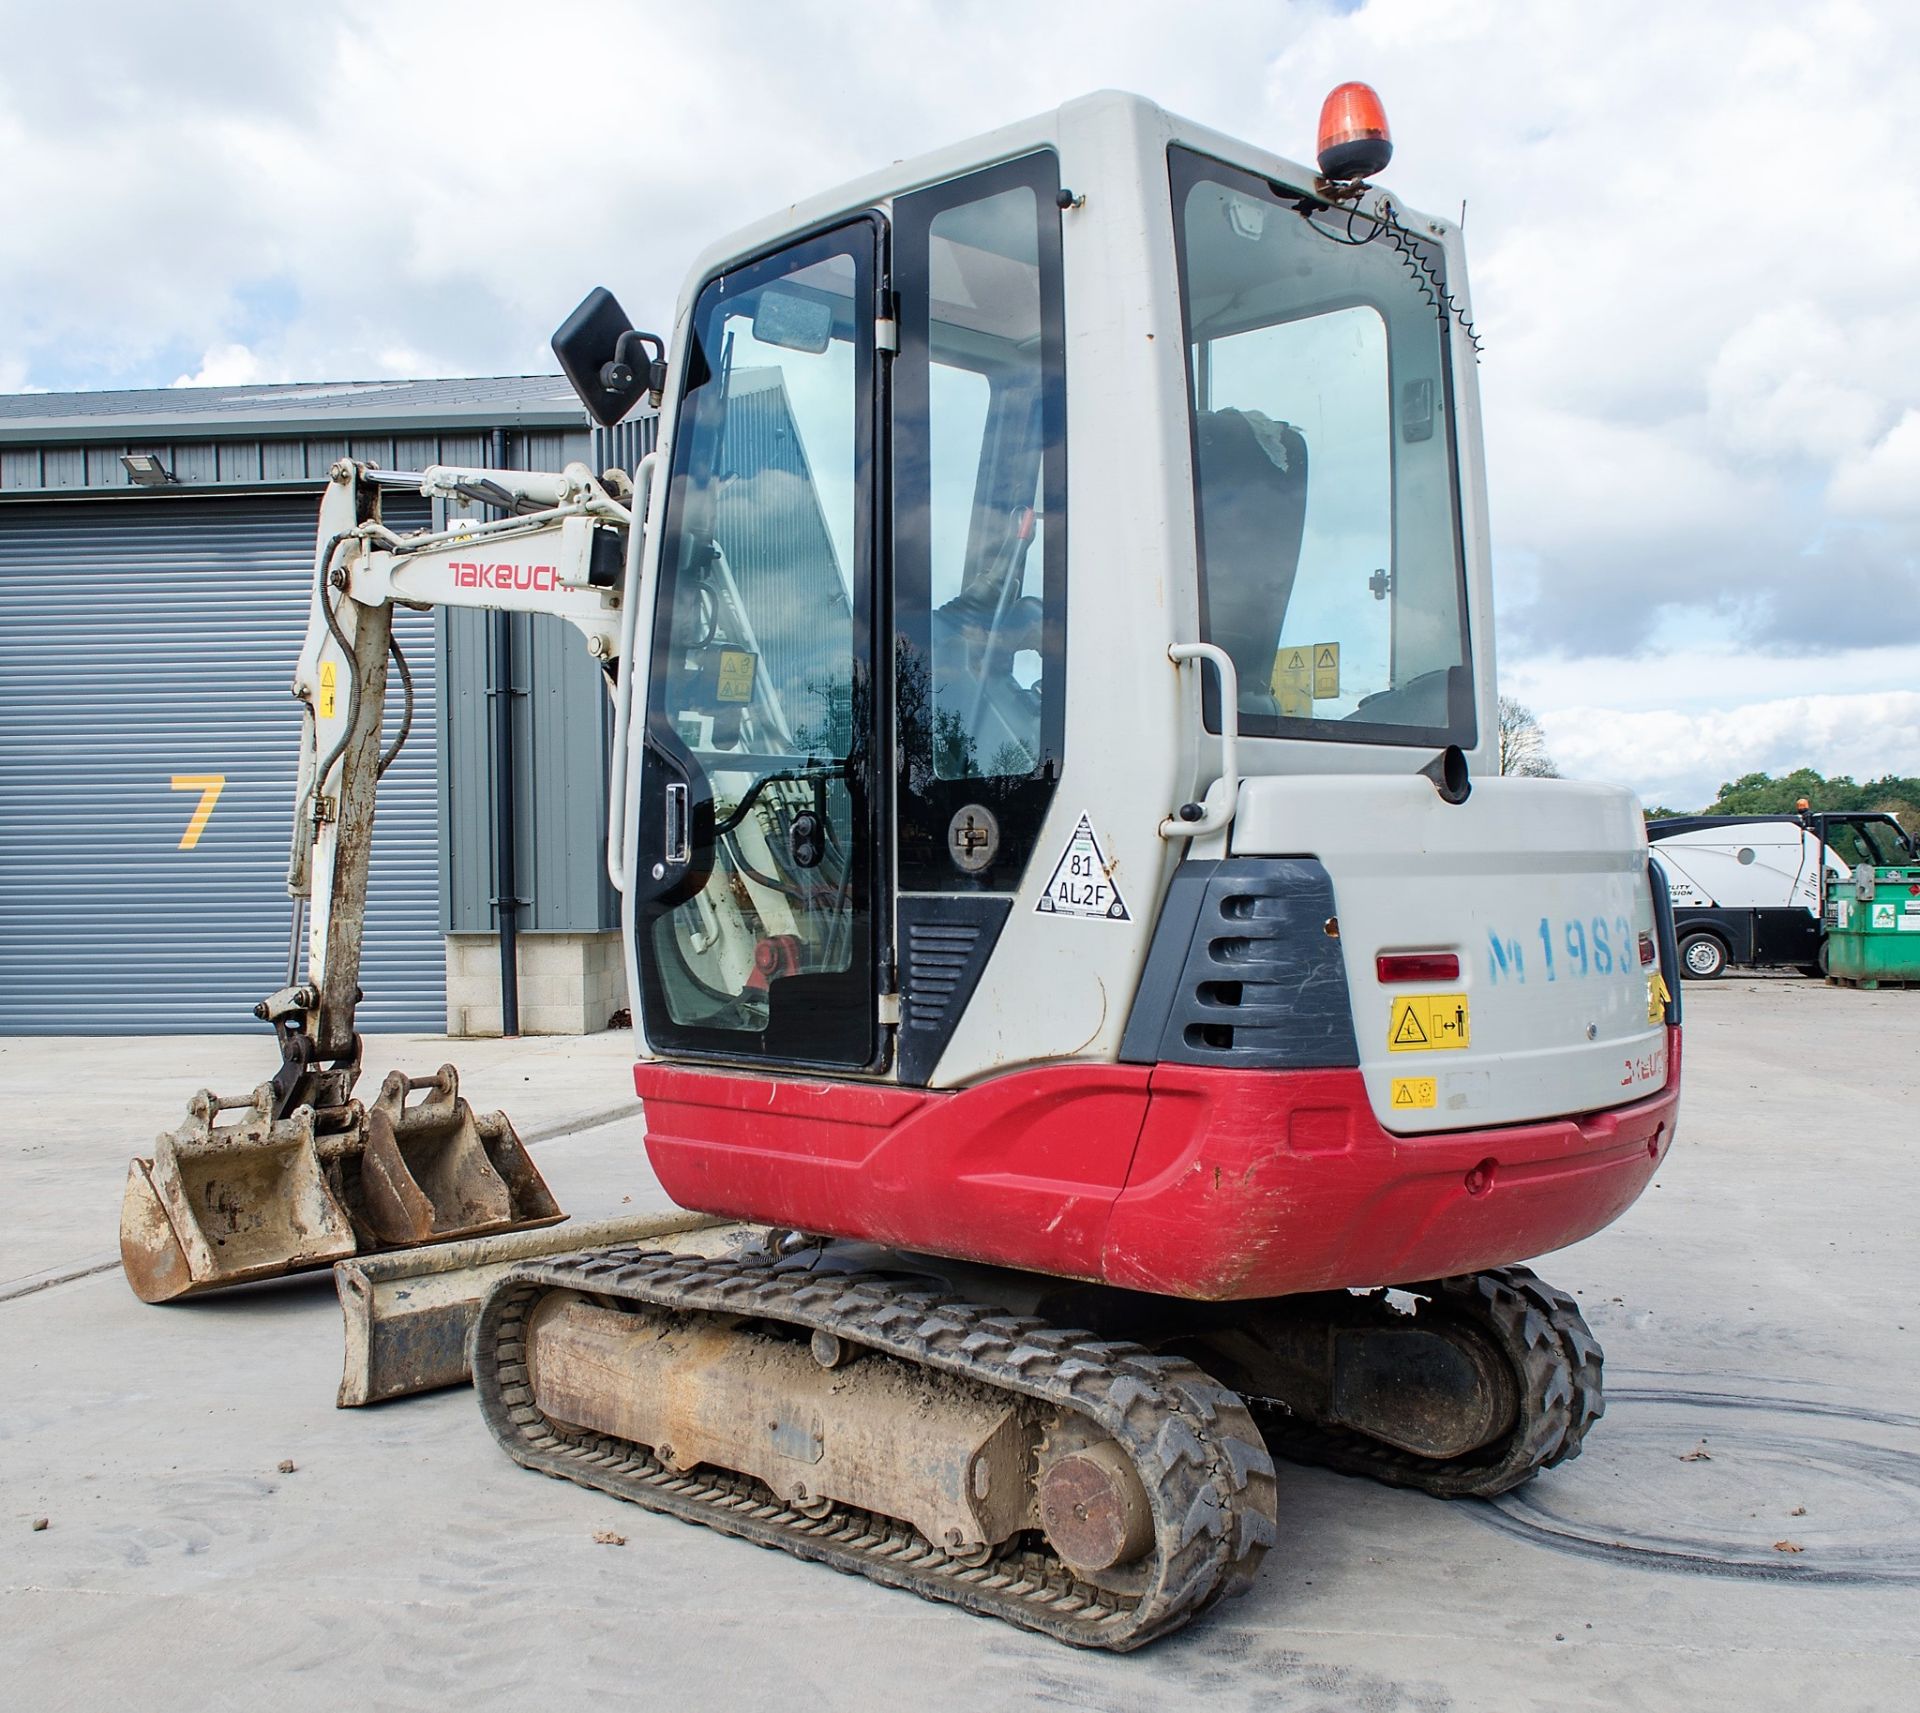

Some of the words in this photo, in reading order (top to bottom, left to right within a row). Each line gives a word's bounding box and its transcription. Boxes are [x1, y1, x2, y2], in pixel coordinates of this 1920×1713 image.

[170, 774, 226, 850] 7
[1070, 854, 1093, 877] 81
[1058, 881, 1108, 906] AL2F
